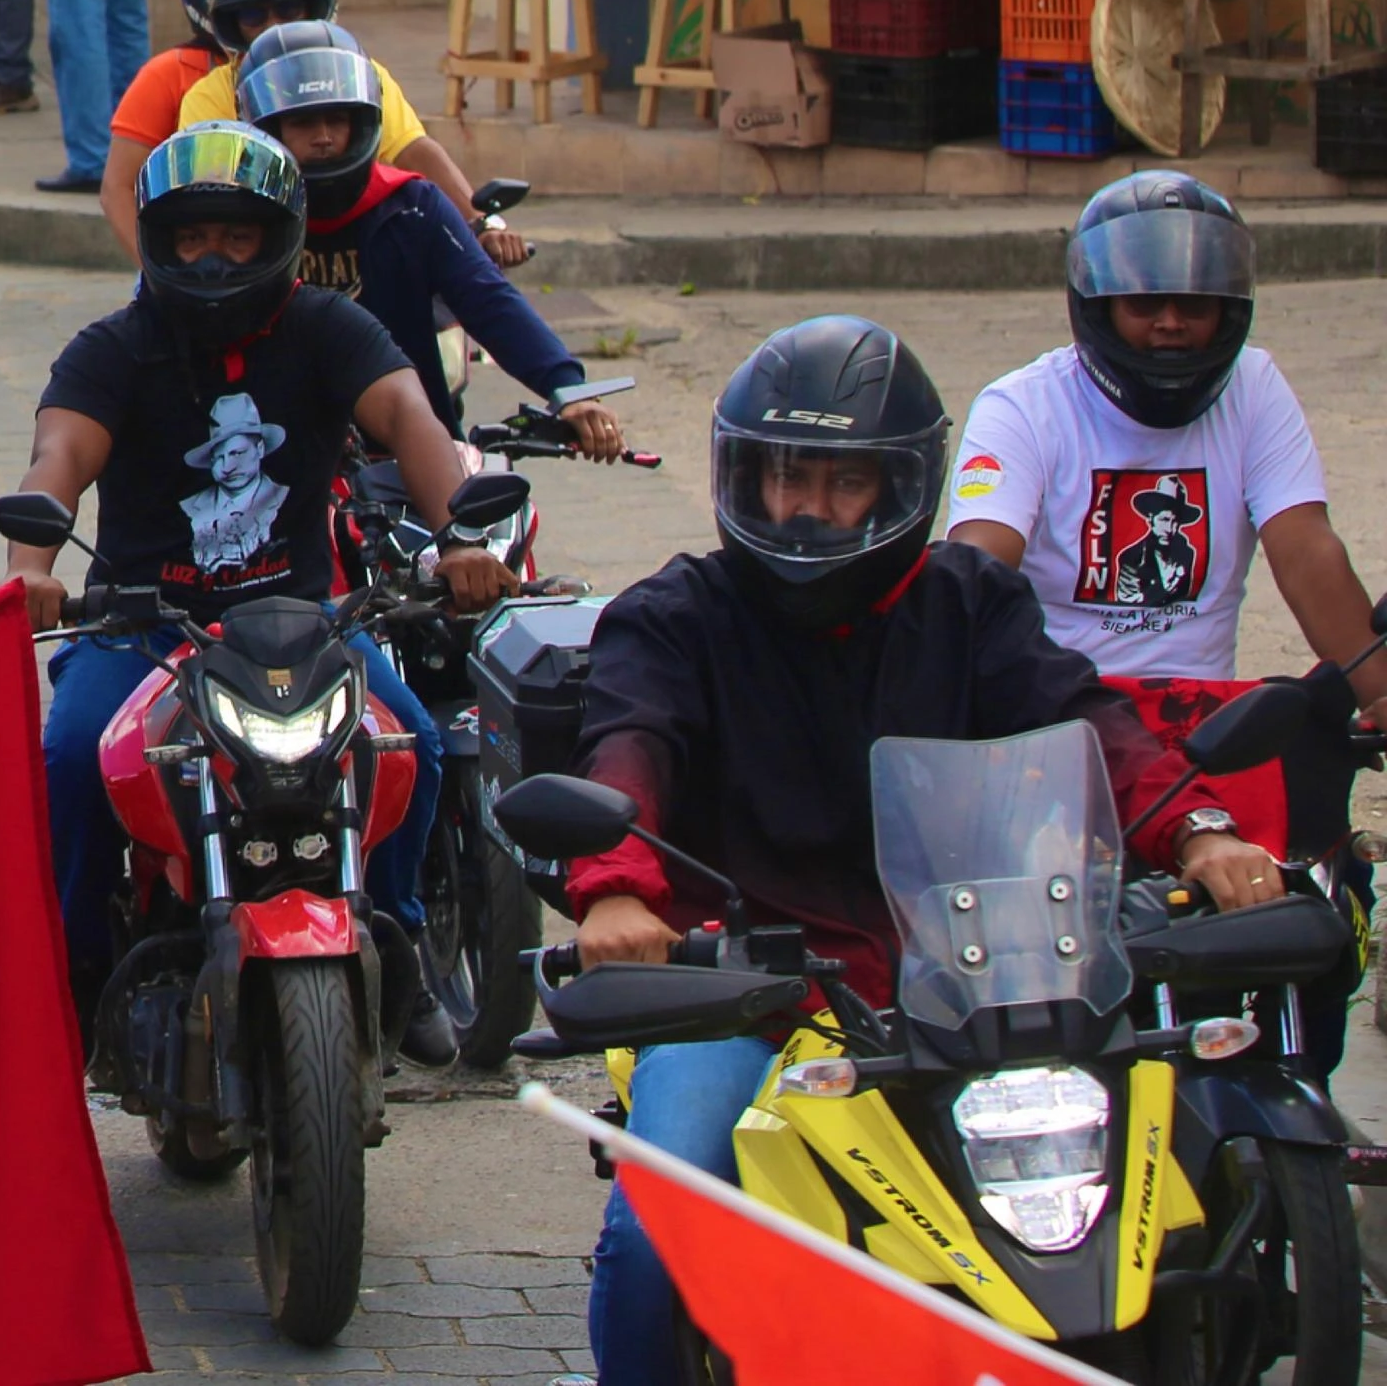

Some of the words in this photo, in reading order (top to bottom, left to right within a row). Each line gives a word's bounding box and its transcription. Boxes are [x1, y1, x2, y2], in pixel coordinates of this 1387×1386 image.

[761, 408, 855, 430] LS2
[1084, 483, 1113, 591] FSLN
[160, 562, 198, 584] LUZ
[846, 1147, 953, 1249] V-STROM
